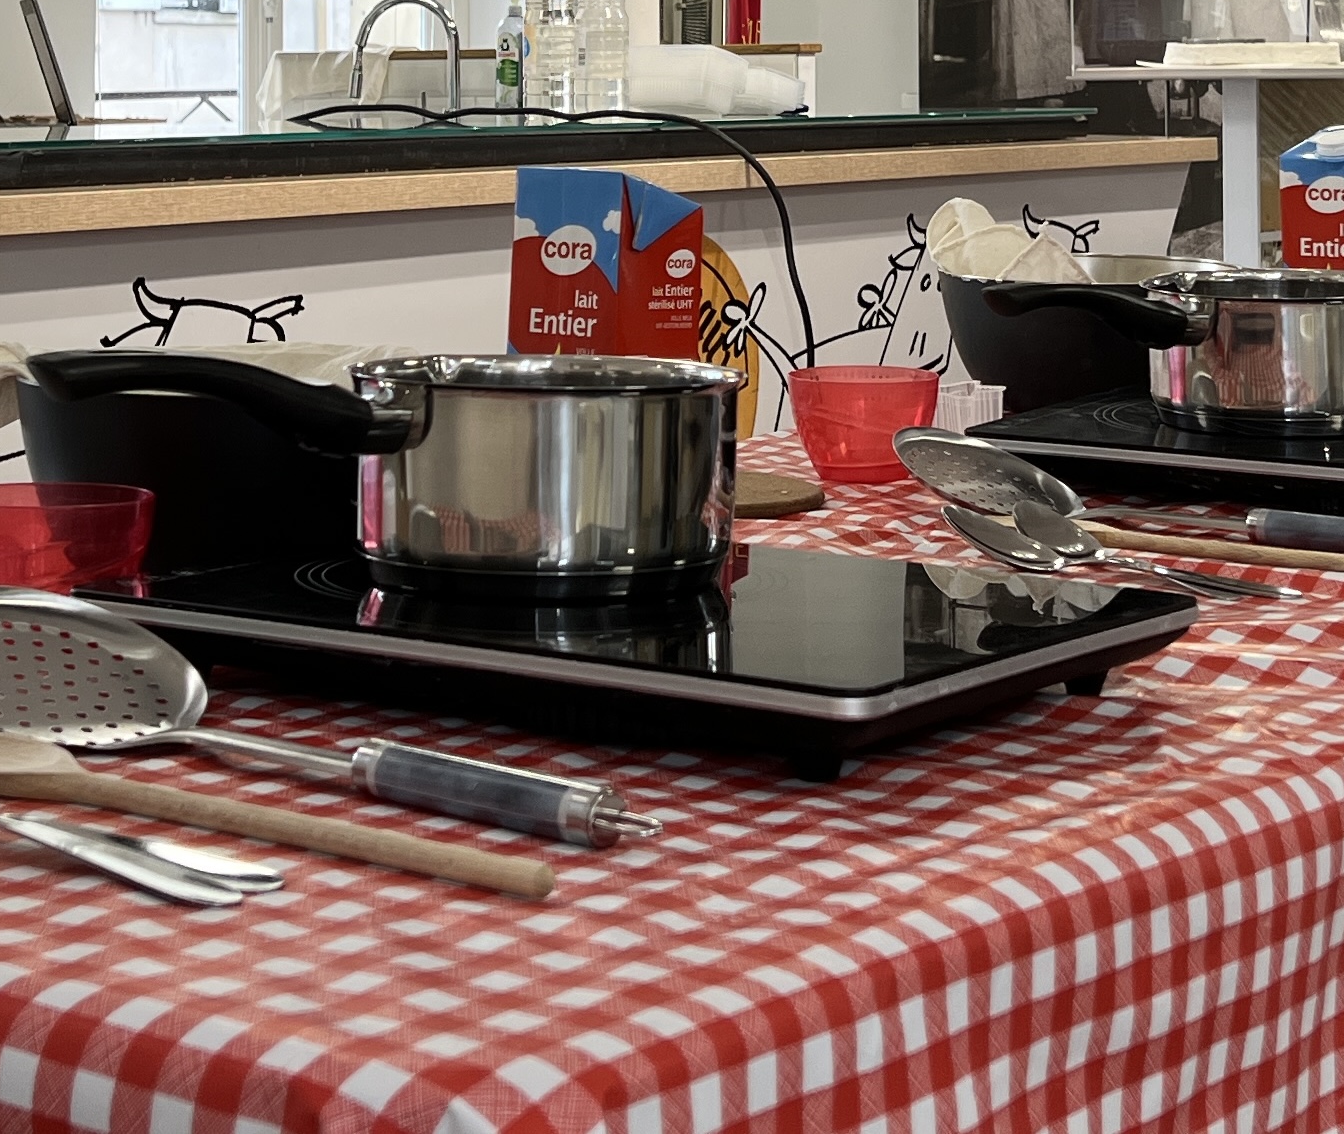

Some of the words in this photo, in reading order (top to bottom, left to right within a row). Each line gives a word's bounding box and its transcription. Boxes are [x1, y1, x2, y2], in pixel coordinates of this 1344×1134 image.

[544, 239, 593, 262] cora
[667, 259, 693, 269] cora
[652, 286, 664, 297] lait
[665, 284, 694, 297] Entier
[574, 290, 598, 310] lait
[648, 299, 675, 310] stérilisé
[676, 299, 694, 310] UHT
[529, 308, 597, 338] Entier
